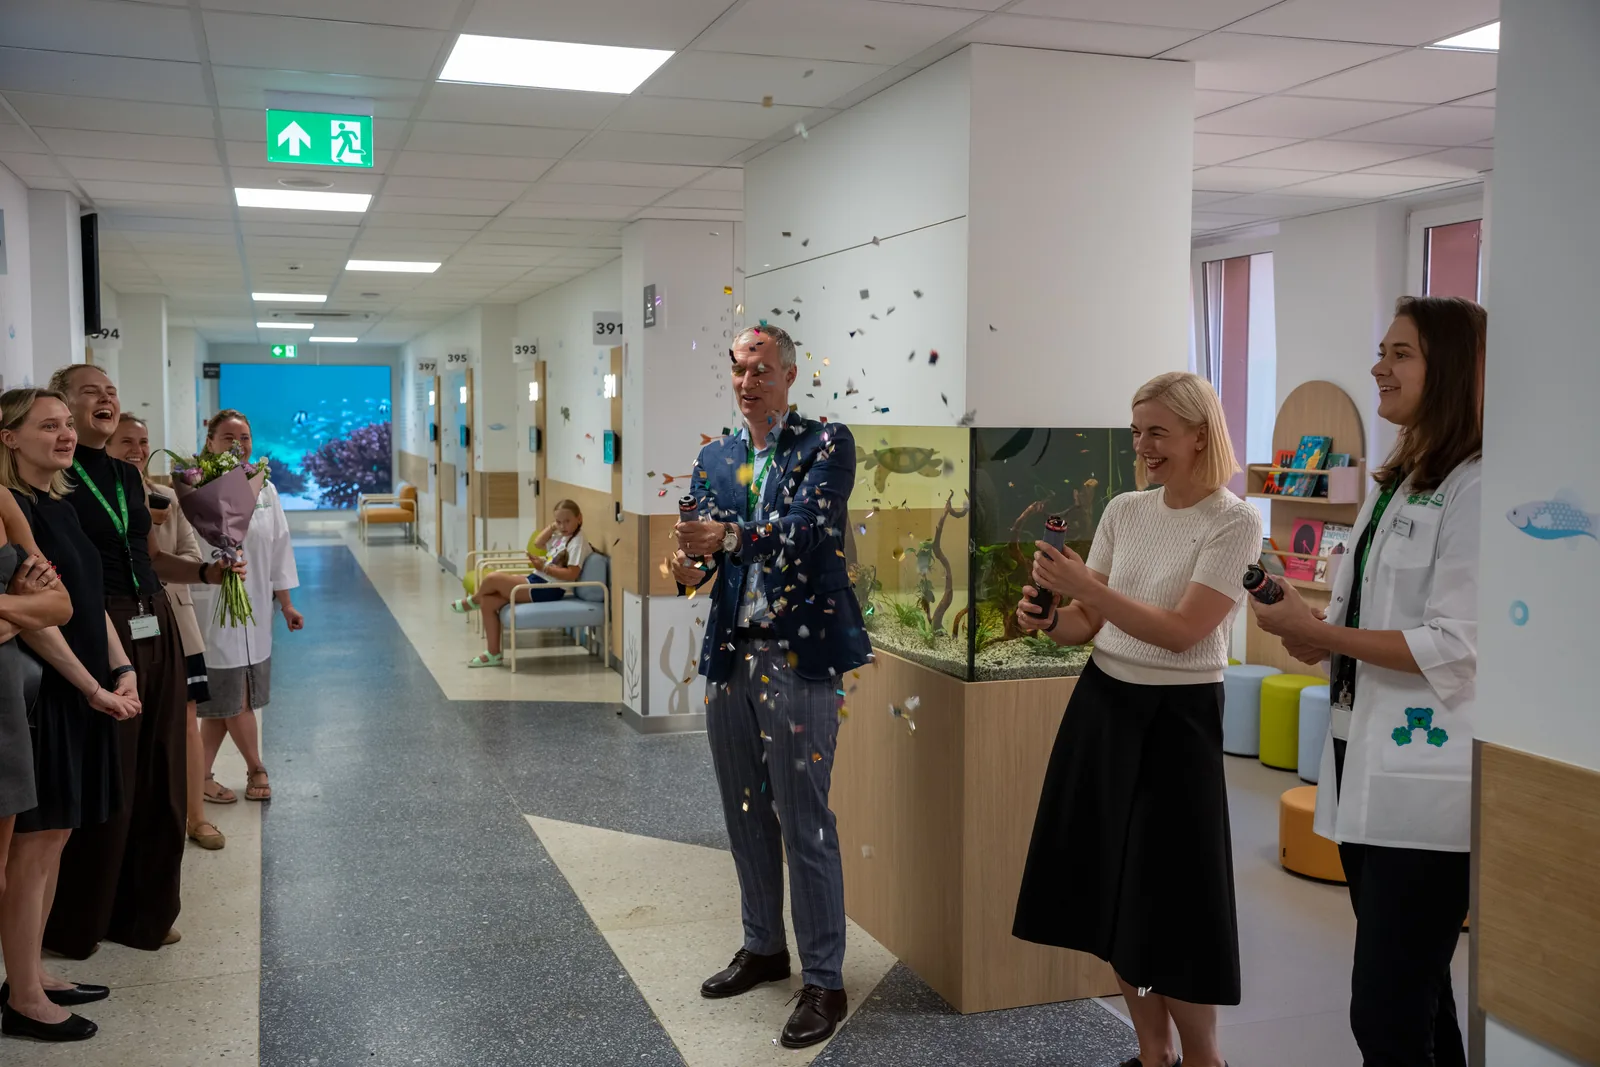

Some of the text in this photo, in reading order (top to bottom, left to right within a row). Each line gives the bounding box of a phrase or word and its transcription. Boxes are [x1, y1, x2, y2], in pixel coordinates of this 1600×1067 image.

[596, 323, 623, 335] 391
[515, 345, 537, 355] 393
[447, 354, 467, 363] 395
[418, 363, 436, 371] 397
